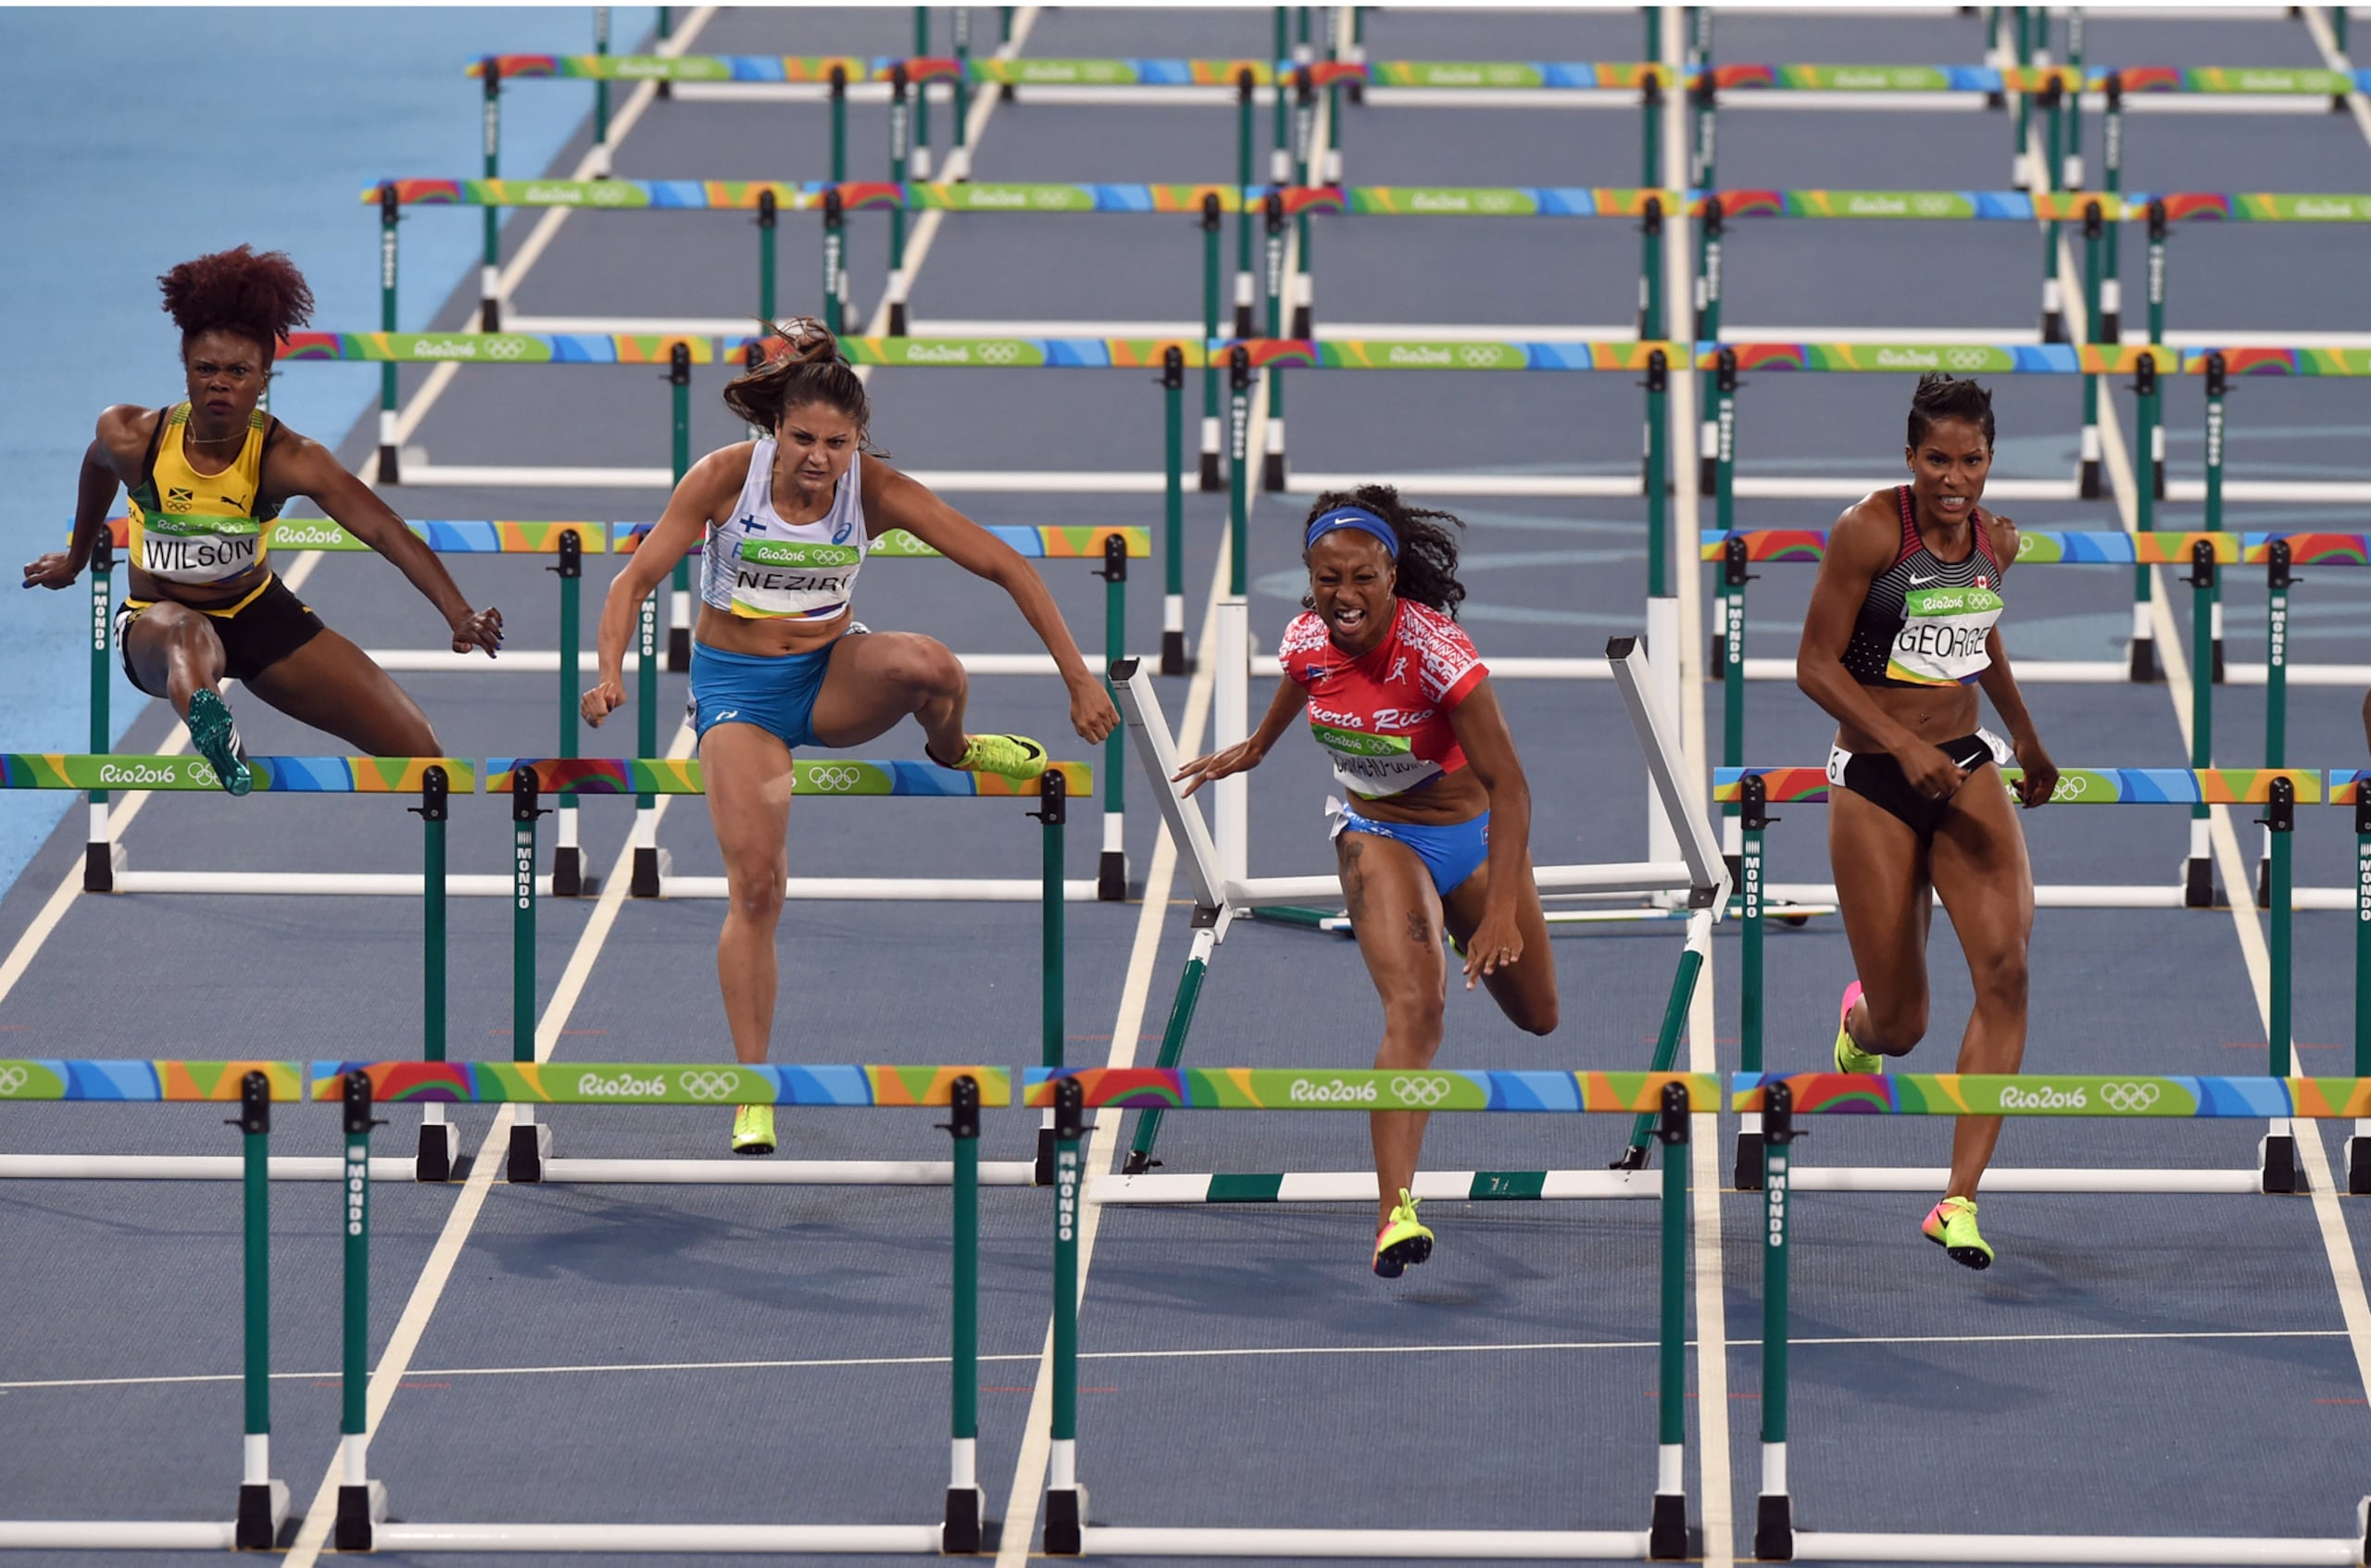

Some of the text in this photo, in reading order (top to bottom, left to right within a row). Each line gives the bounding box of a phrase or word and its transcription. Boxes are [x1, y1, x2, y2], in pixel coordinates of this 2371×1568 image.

[414, 339, 475, 358] Rio2016
[907, 344, 970, 362] Rio2016
[1389, 345, 1451, 364] Rio2016
[1876, 348, 1938, 367] Rio2016
[274, 525, 343, 544] Rio2016
[145, 539, 256, 571] WILSON
[758, 546, 805, 562] Rio2016
[736, 571, 851, 591] NEZIRI
[1923, 596, 1963, 609] Rio2016
[94, 595, 107, 650] MONDO
[642, 602, 655, 656] MONDO
[1728, 608, 1743, 664] MONDO
[1898, 623, 1991, 659] GEORGE
[2271, 610, 2286, 666] MONDO
[1372, 708, 1436, 733] Rico
[100, 764, 175, 784] Rio2016
[1829, 750, 1840, 780] 6
[517, 847, 532, 909] MONDO
[1745, 857, 1760, 919] MONDO
[578, 1072, 667, 1097] Rio2016
[1289, 1079, 1377, 1101] Rio2016
[2000, 1085, 2088, 1109] Rio2016
[348, 1164, 365, 1236] MONDO
[1059, 1170, 1076, 1241] MONDO
[1768, 1175, 1786, 1247] MONDO
